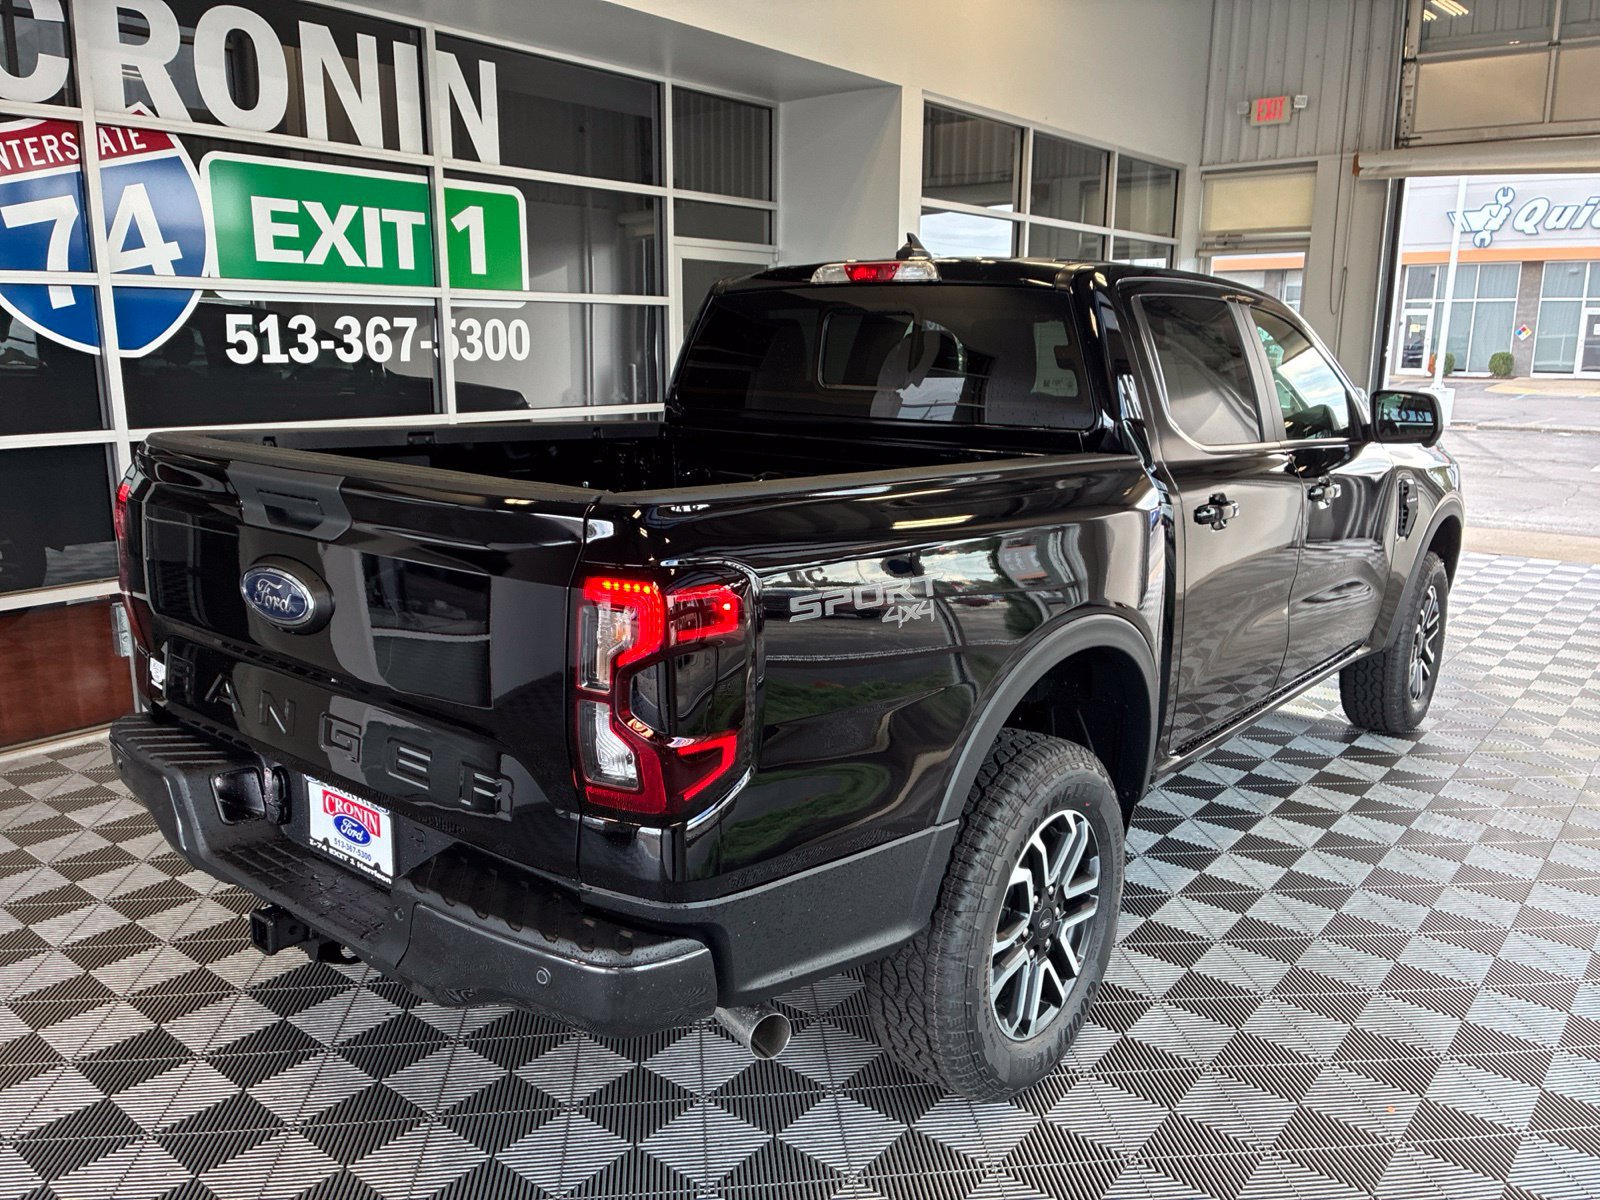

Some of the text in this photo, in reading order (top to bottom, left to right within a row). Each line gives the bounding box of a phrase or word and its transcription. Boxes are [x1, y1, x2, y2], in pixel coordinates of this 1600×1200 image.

[0, 0, 500, 165] CRONIN
[1257, 96, 1286, 121] EXIT
[0, 126, 147, 171] NTERSATE
[2, 182, 183, 310] 74
[250, 195, 488, 275] EXIT 1
[254, 578, 292, 613] Ford
[789, 572, 945, 623] SPORT
[168, 652, 513, 822] RANGER
[325, 793, 379, 837] CRONIN
[340, 818, 364, 842] Ford
[309, 838, 328, 852] I-74
[328, 846, 350, 861] EXIT
[356, 861, 392, 885] Harrison
[334, 837, 372, 862] 513-367-5300
